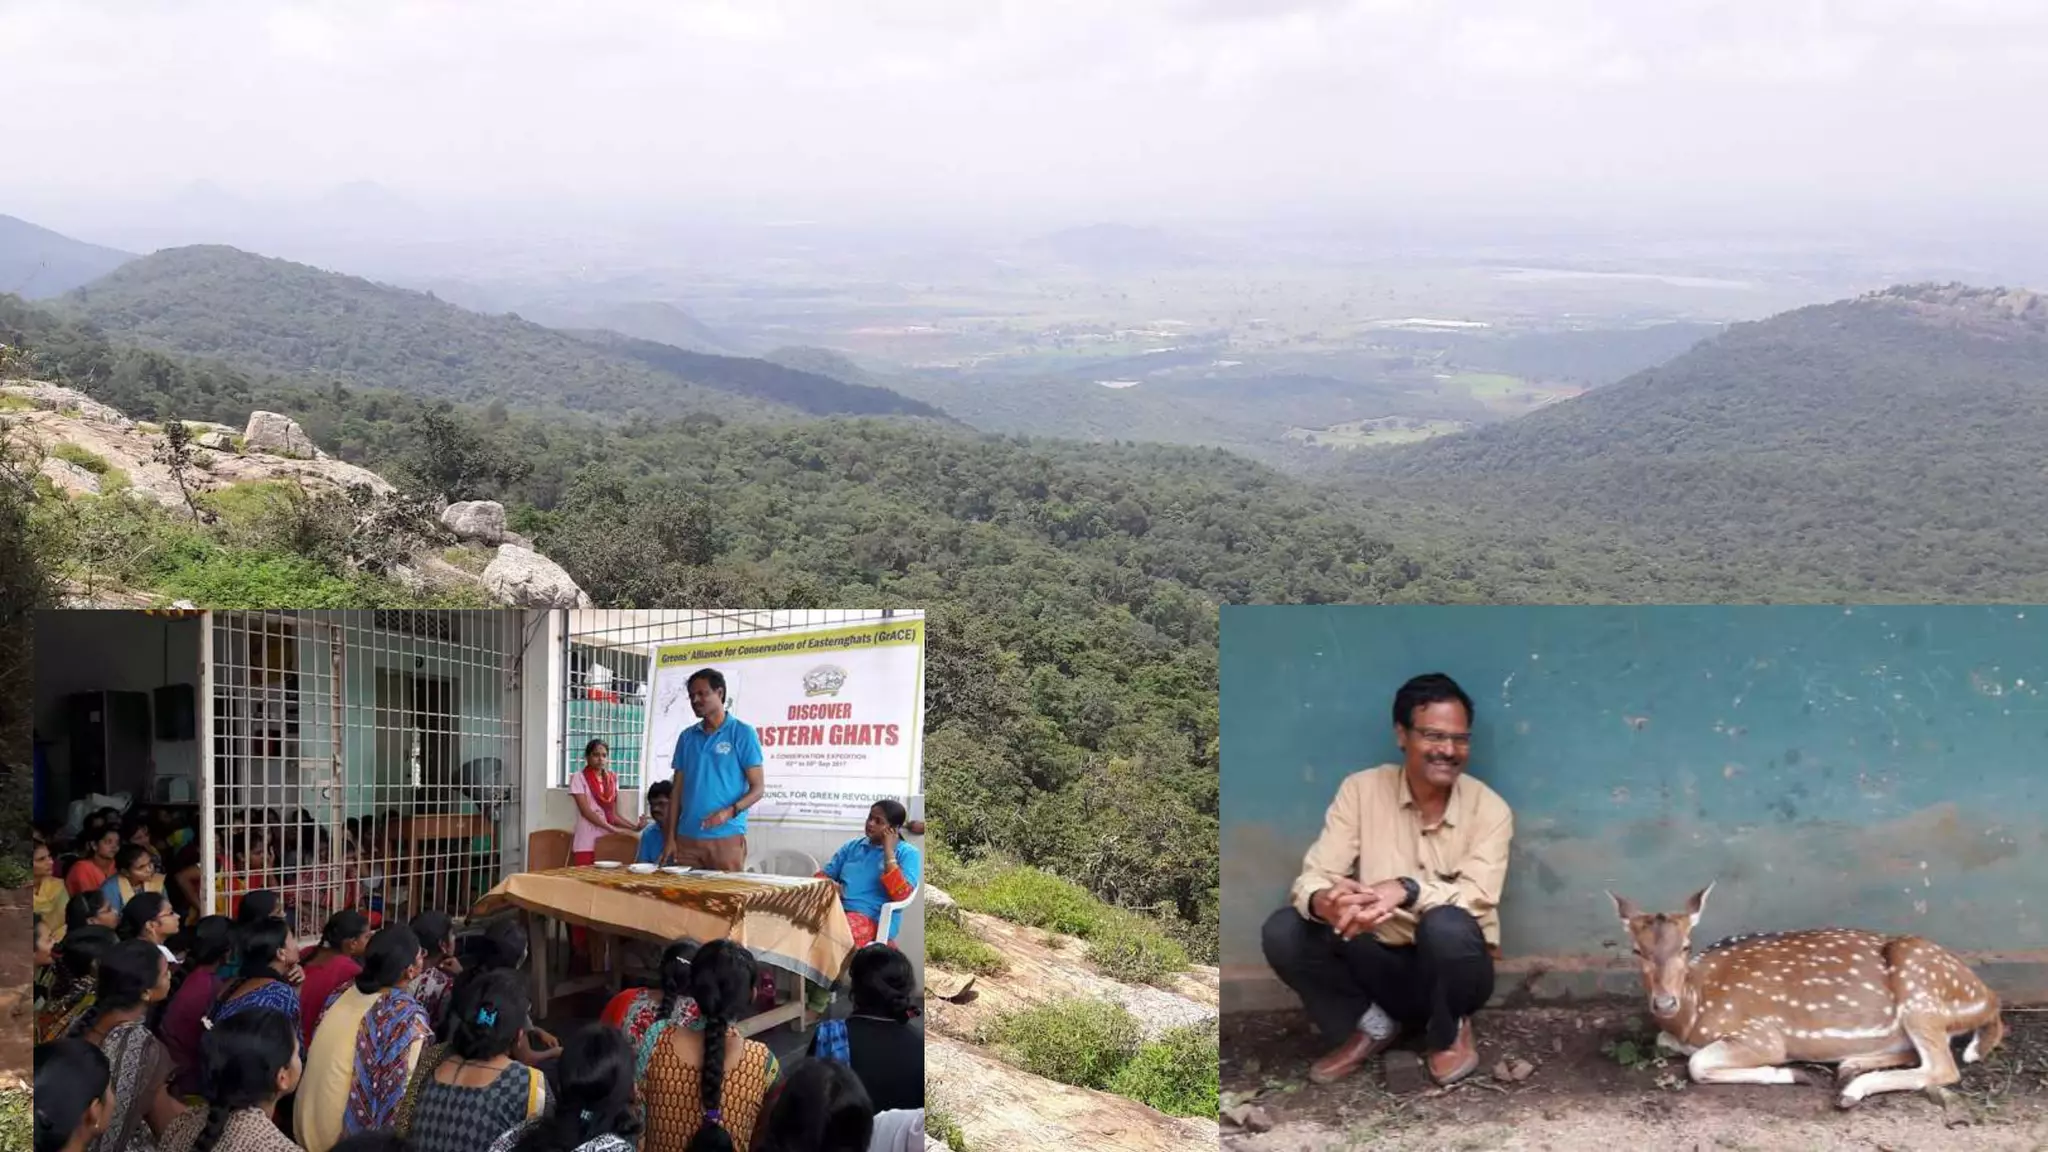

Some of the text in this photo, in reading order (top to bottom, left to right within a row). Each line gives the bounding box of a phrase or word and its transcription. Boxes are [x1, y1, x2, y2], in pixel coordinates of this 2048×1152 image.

[691, 649, 724, 660] Alliance
[724, 647, 737, 657] for
[738, 642, 797, 656] Conservation
[796, 640, 806, 650] of
[808, 634, 872, 648] Easternghats
[874, 629, 916, 645] (GrACE)
[788, 703, 852, 720] DISCOVER
[756, 724, 899, 746] ASTERN GHATS
[762, 791, 900, 801] OUNCIL FOR GREEN REVOLUTION
